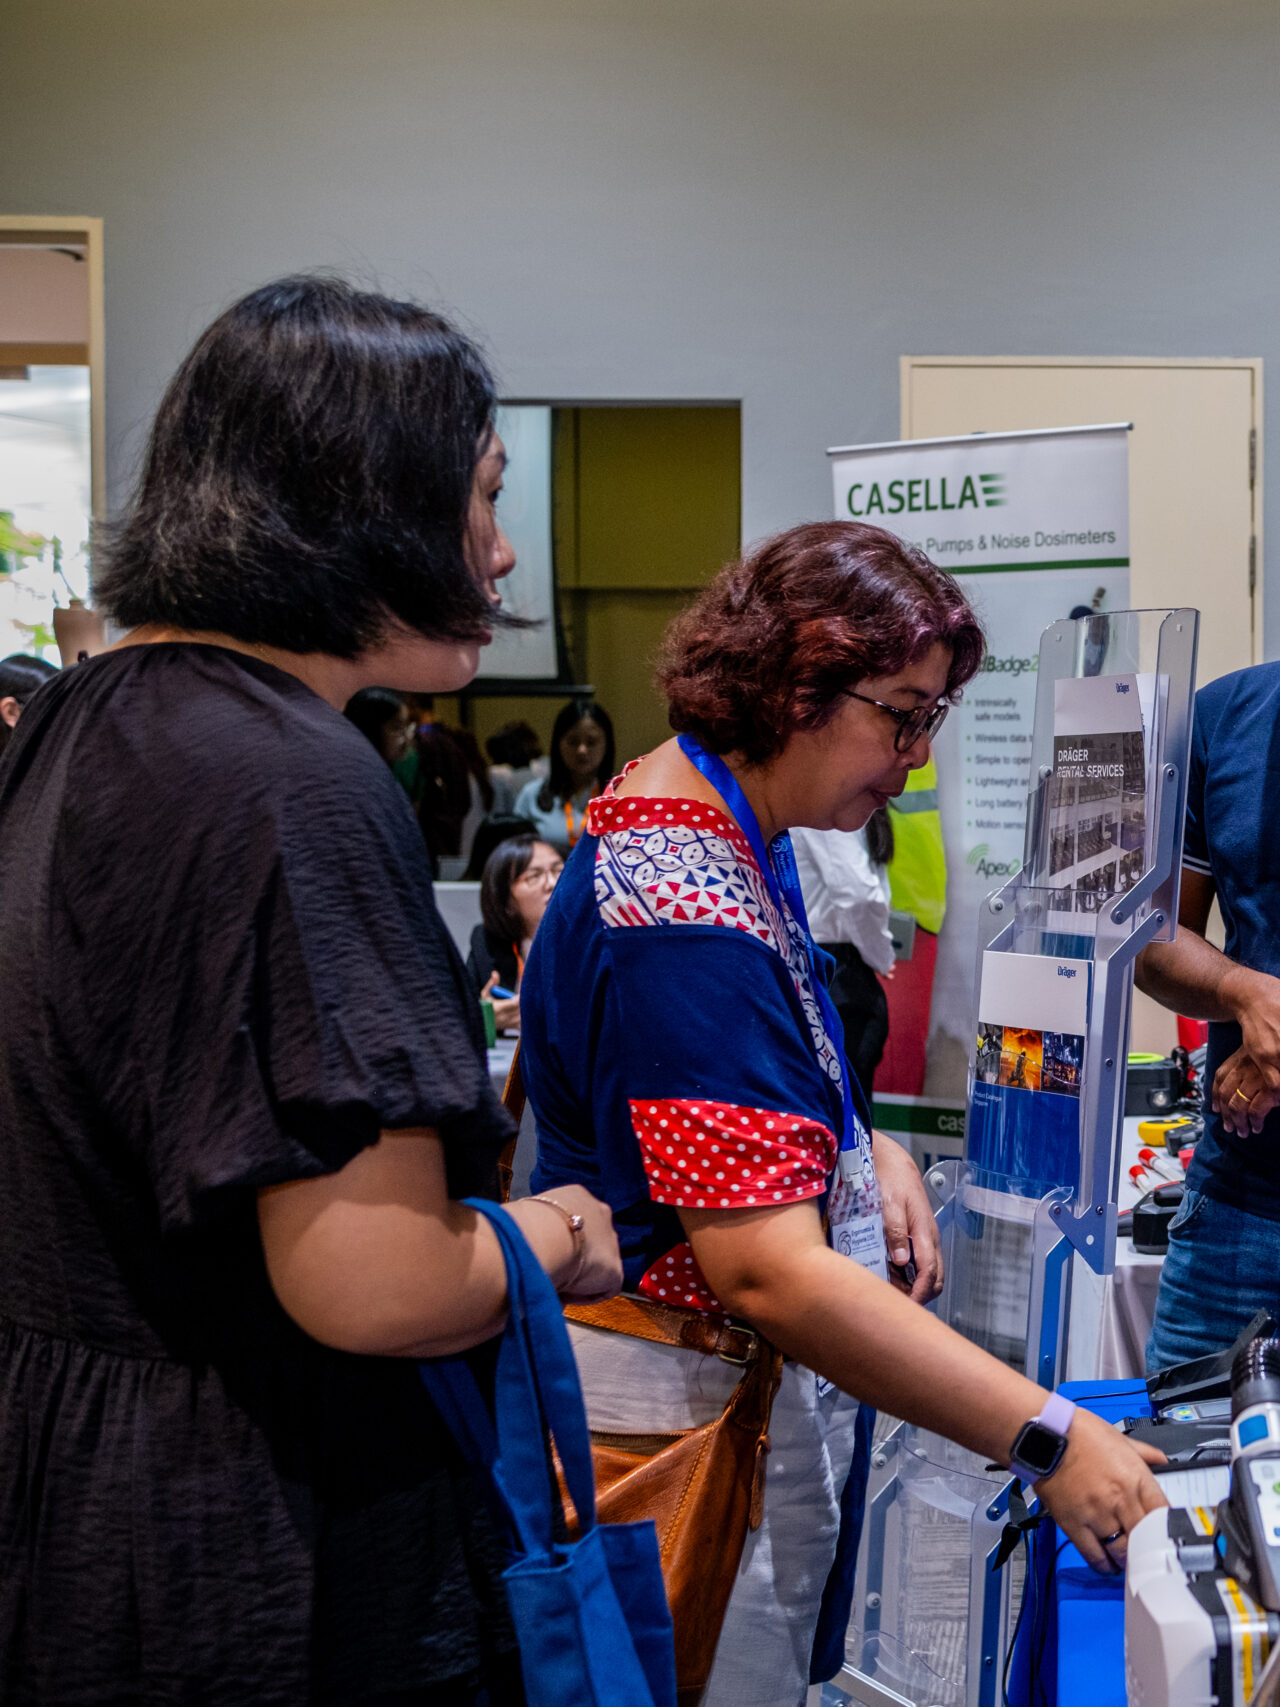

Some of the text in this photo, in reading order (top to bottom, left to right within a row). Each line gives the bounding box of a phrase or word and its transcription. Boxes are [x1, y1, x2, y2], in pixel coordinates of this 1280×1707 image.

[847, 475, 980, 516] CASELLA
[926, 537, 974, 555] Pumps
[978, 534, 987, 550] &
[991, 531, 1031, 549] Noise
[1034, 528, 1117, 547] Dosimeters
[974, 697, 1017, 710] Intrinsically
[974, 711, 1021, 721] safe models
[974, 733, 1008, 743] Wireless
[1009, 733, 1026, 743] data
[974, 755, 1002, 766] Simple
[1003, 756, 1011, 765] to
[1057, 747, 1089, 762] DRÄGER
[1056, 763, 1125, 779] RENTAL SERVICES
[974, 777, 1019, 788] Lightweight
[975, 799, 995, 810] Long
[996, 799, 1023, 811] battery
[975, 818, 1001, 830] Motion
[975, 857, 1021, 880] Apex2
[1057, 965, 1077, 979] Dräger
